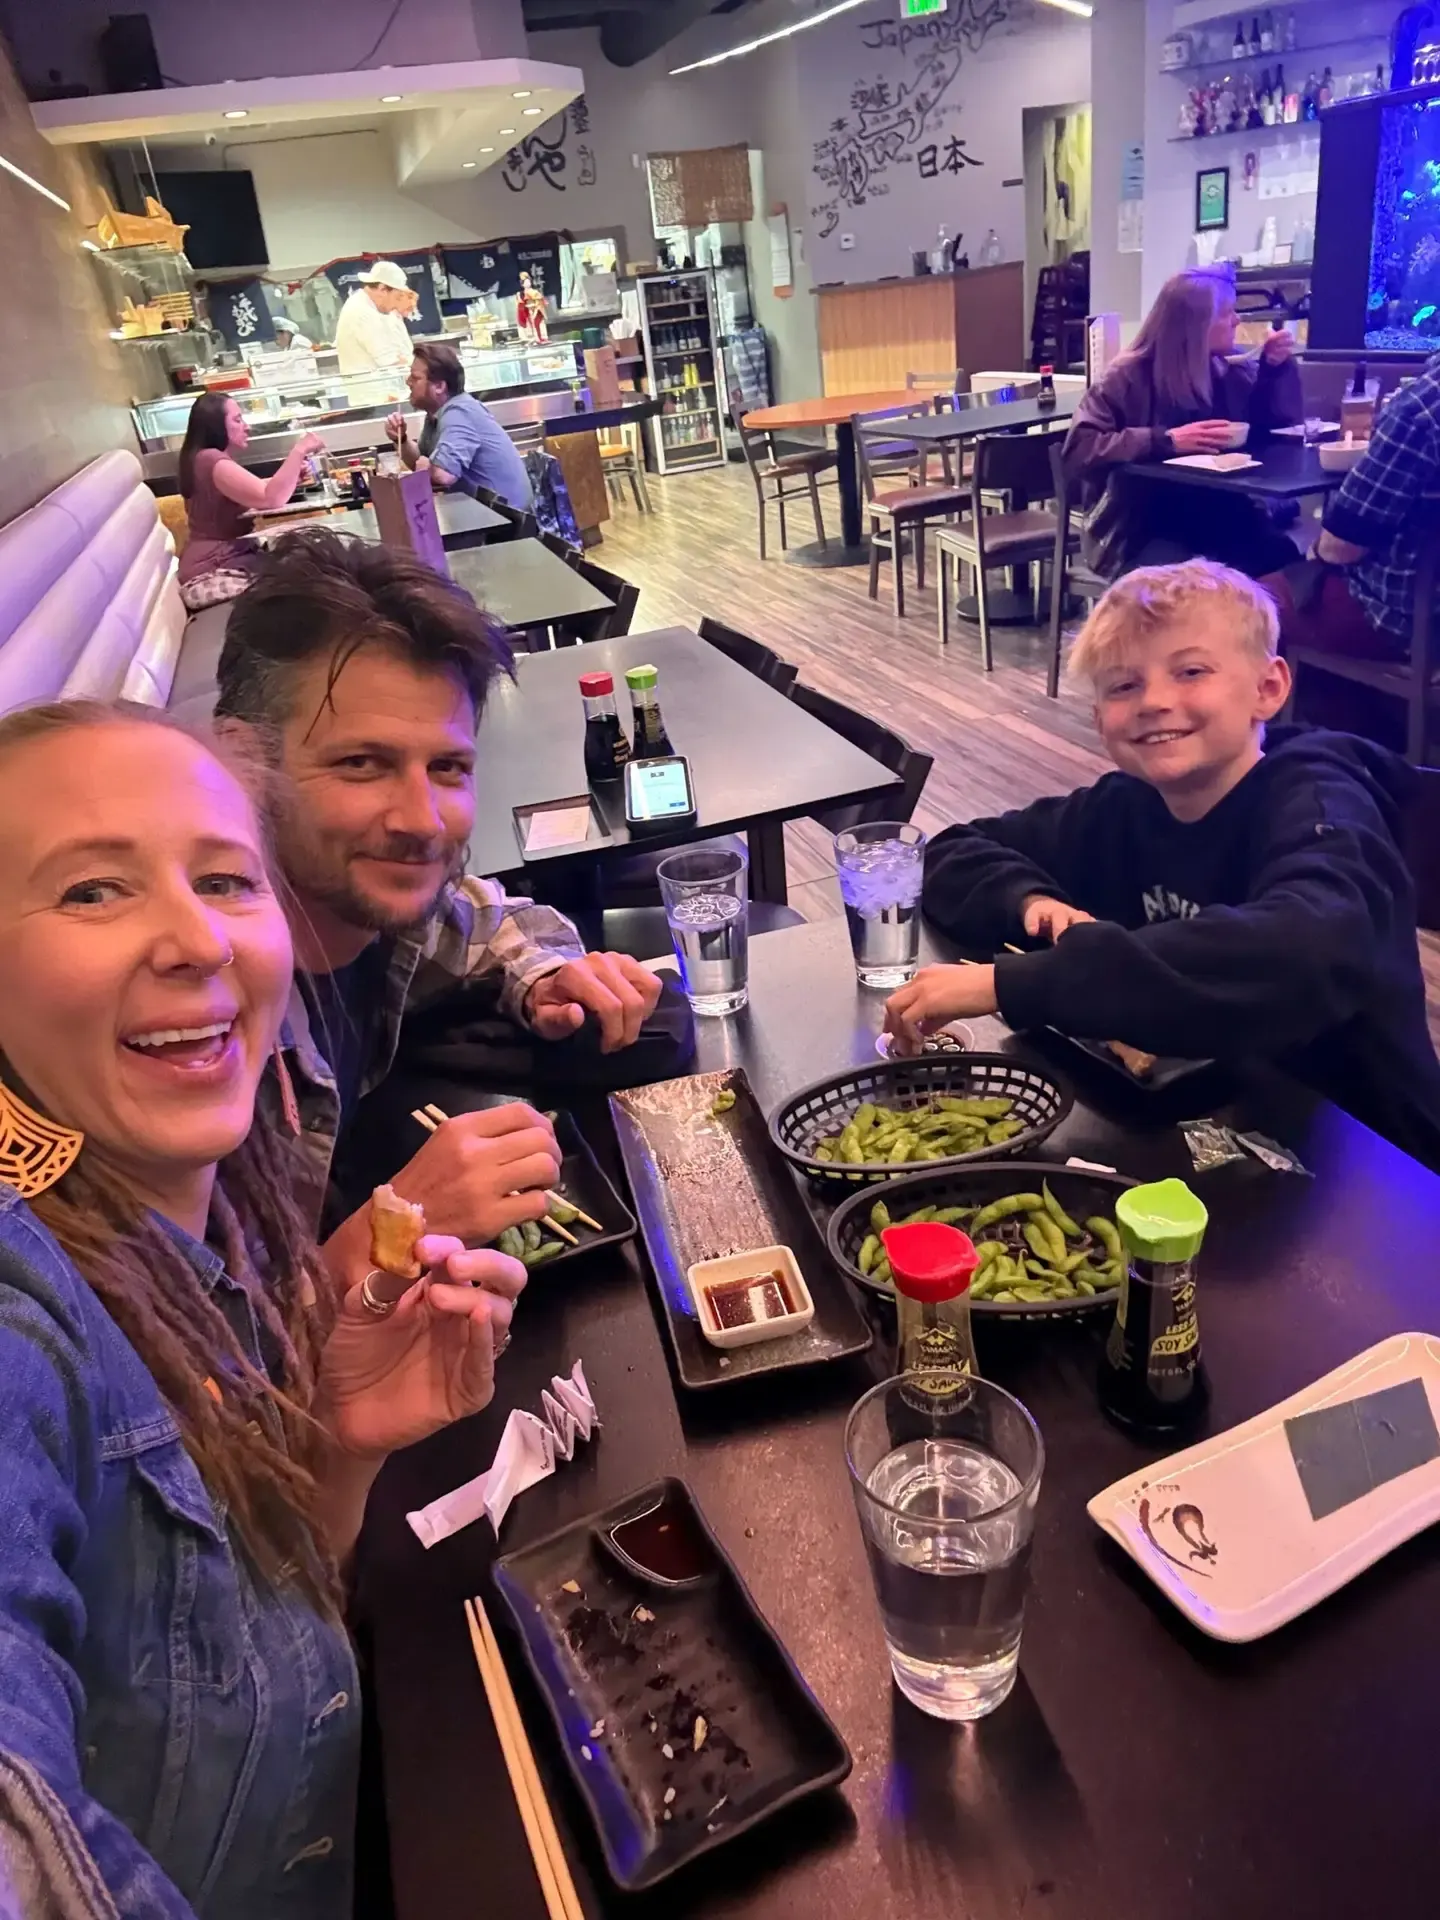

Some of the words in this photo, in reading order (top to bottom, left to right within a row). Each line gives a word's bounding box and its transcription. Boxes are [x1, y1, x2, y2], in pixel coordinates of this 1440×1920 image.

[859, 19, 944, 55] Japan
[917, 135, 984, 178] 日本
[1156, 1339, 1181, 1351] SOY
